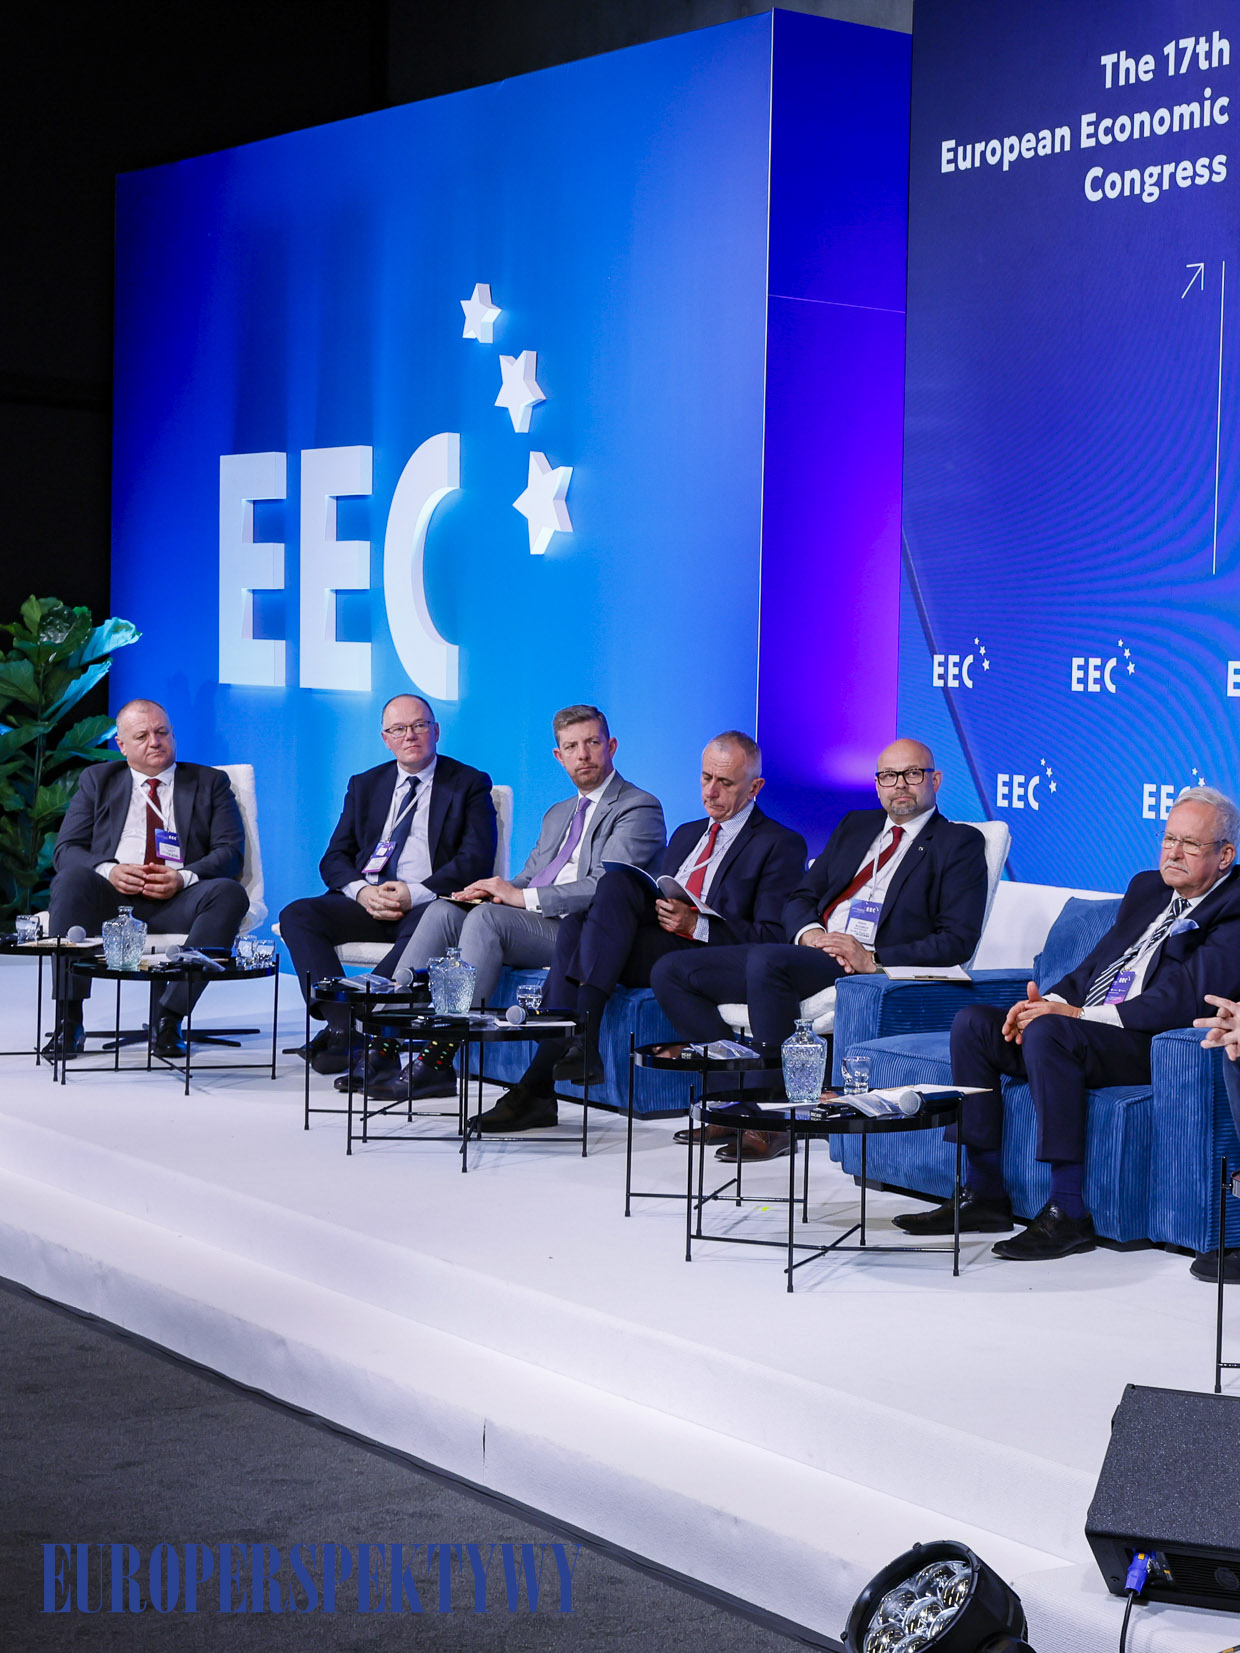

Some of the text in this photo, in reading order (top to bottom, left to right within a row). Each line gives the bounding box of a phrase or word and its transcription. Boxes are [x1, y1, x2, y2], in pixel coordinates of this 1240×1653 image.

[1101, 30, 1231, 89] The 17th
[941, 87, 1230, 173] European Economic
[1084, 154, 1228, 203] Congress
[219, 432, 461, 700] EEC
[932, 654, 974, 689] EEC
[1071, 657, 1117, 694] EEC
[996, 773, 1040, 811] EEC
